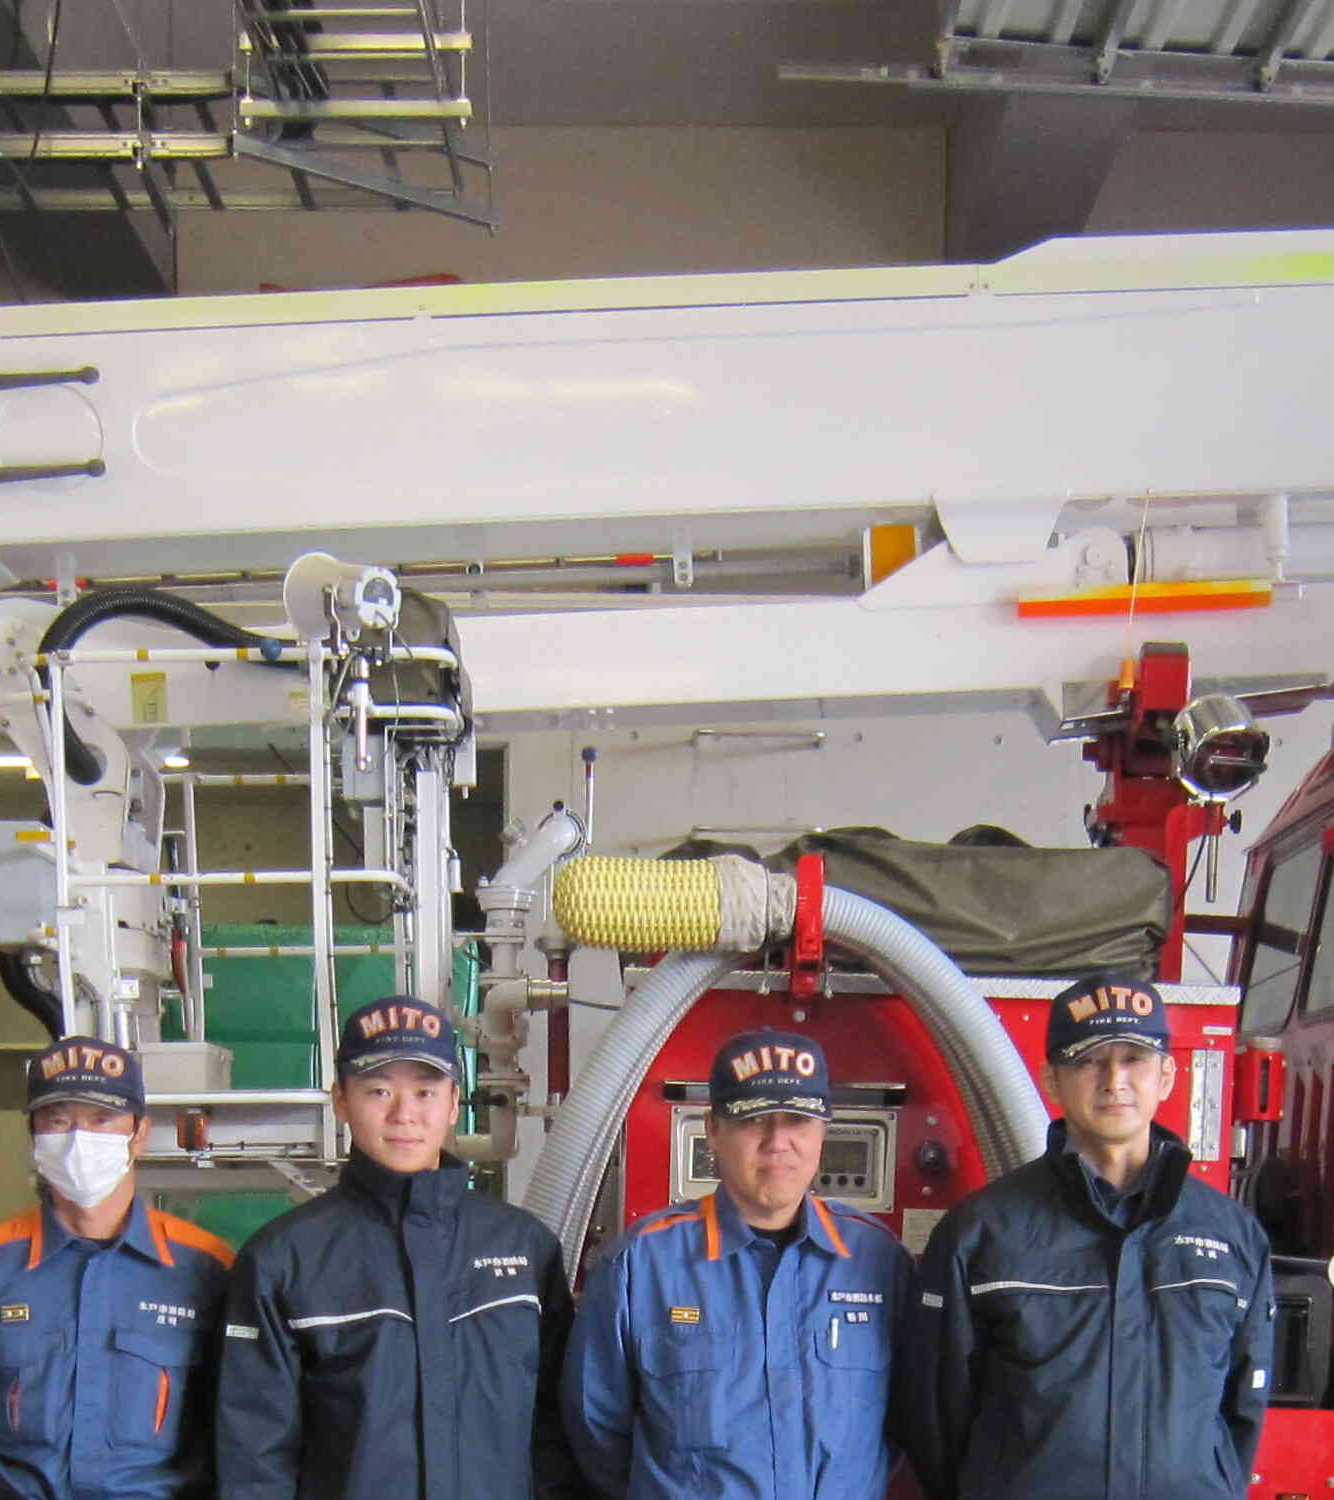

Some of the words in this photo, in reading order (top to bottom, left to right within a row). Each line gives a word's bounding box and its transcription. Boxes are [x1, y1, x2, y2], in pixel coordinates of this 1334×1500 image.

[359, 1005, 441, 1038] MITO
[1067, 986, 1153, 1023] MITO
[41, 1045, 125, 1079] MITO
[730, 1045, 816, 1082] MITO
